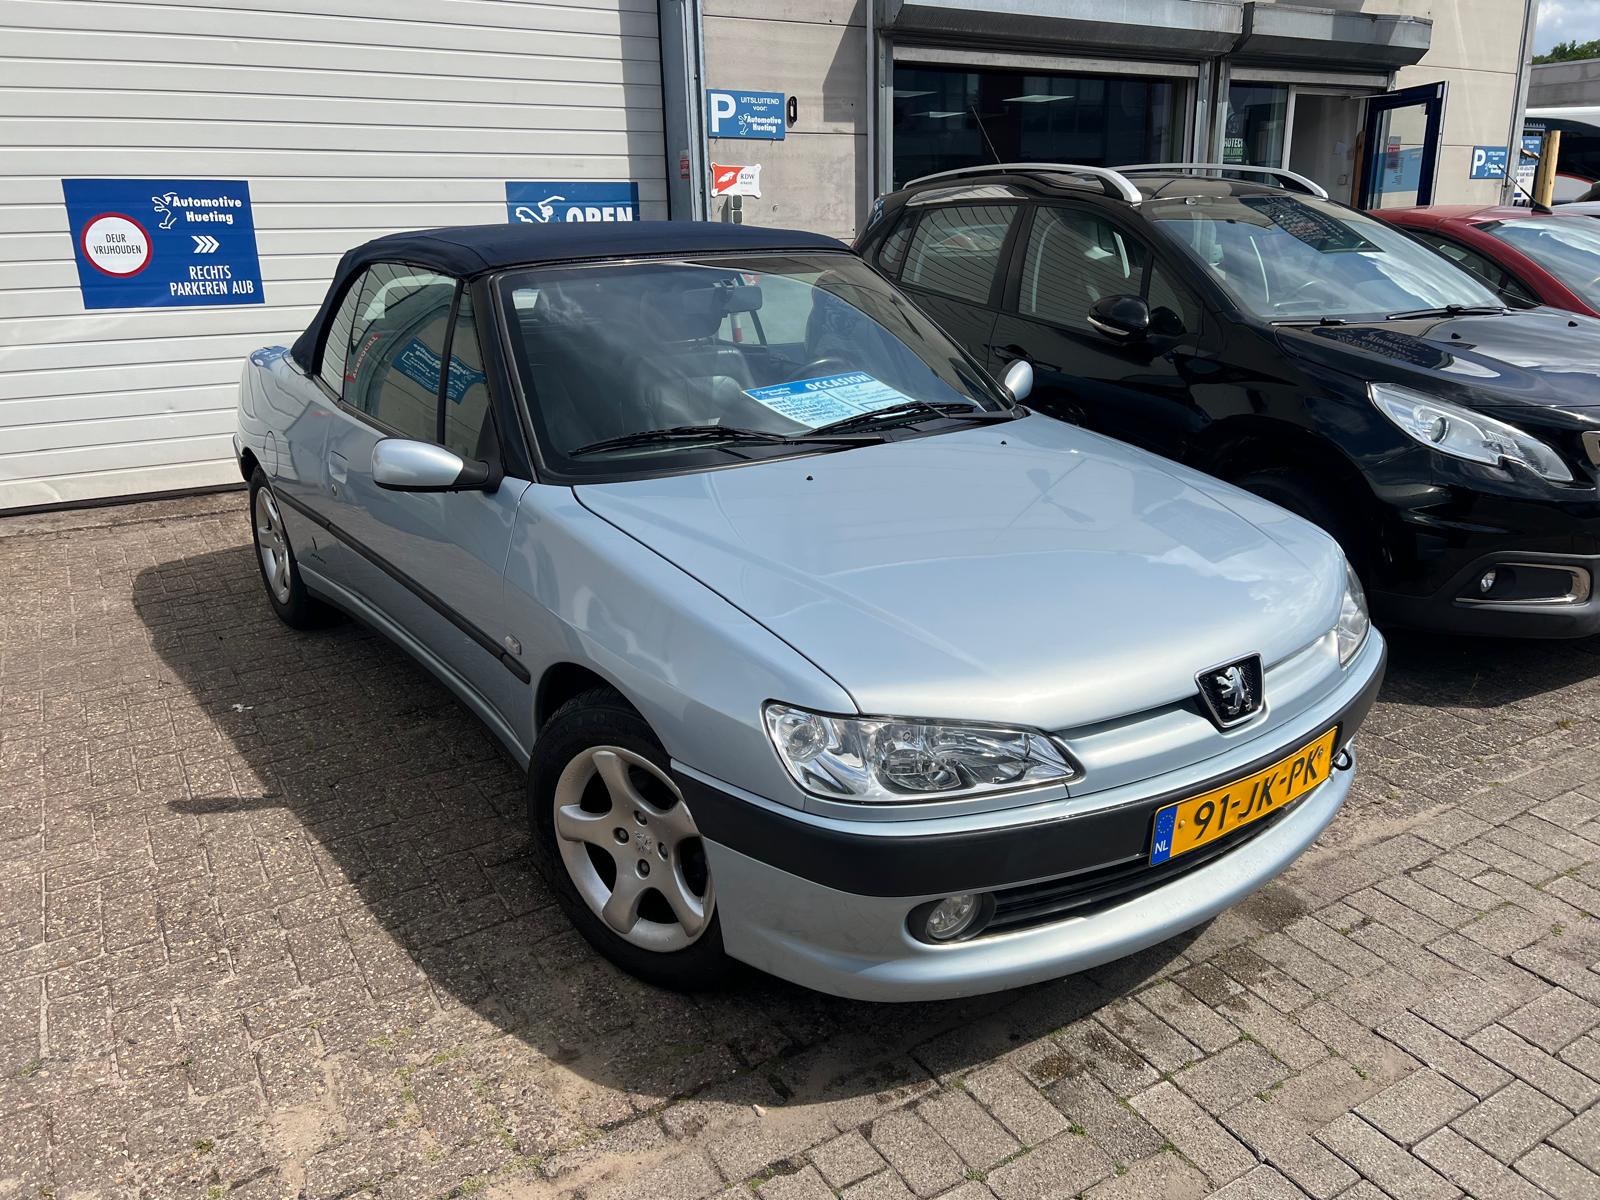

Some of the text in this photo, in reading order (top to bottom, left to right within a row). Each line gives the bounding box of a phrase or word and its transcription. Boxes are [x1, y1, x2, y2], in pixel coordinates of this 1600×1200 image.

[740, 96, 780, 105] UITSLUITEND
[710, 93, 737, 133] P
[746, 115, 782, 124] Automotive
[752, 124, 777, 133] Hueting
[1472, 149, 1486, 176] P
[172, 195, 242, 208] Automotive
[185, 210, 234, 225] Hueting
[105, 233, 127, 243] DEUR
[93, 244, 142, 255] VRIJHOUDEN
[188, 265, 232, 280] RECHTS
[169, 279, 254, 296] PARKEREN AUB
[804, 374, 873, 391] OCCASION
[1193, 744, 1323, 841] 91-JK-PK
[1154, 839, 1169, 855] NL
